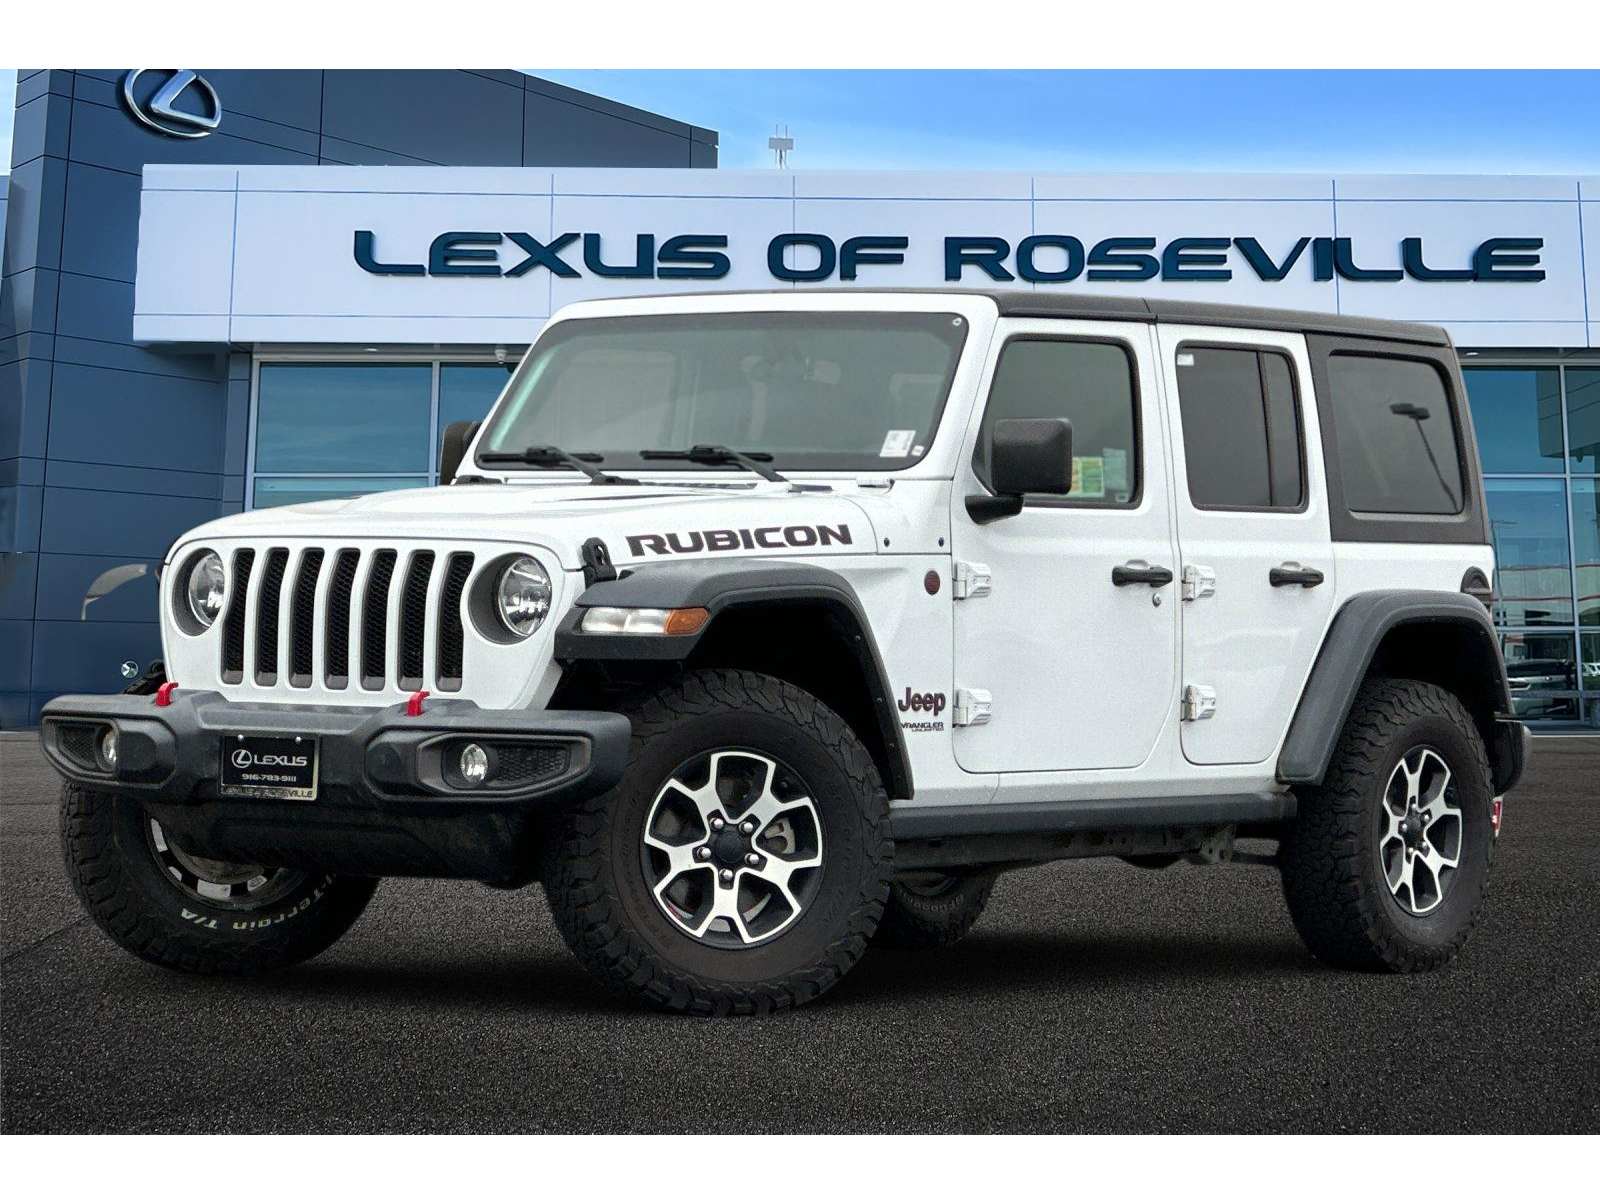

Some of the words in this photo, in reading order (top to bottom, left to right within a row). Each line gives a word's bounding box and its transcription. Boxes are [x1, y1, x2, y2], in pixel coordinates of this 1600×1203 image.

[353, 230, 730, 279] LEXUS
[767, 233, 909, 282] OF
[944, 234, 1546, 283] ROSEVILLE
[625, 524, 853, 557] RUBICON
[897, 686, 946, 716] Jeep
[253, 754, 308, 767] LEXUS
